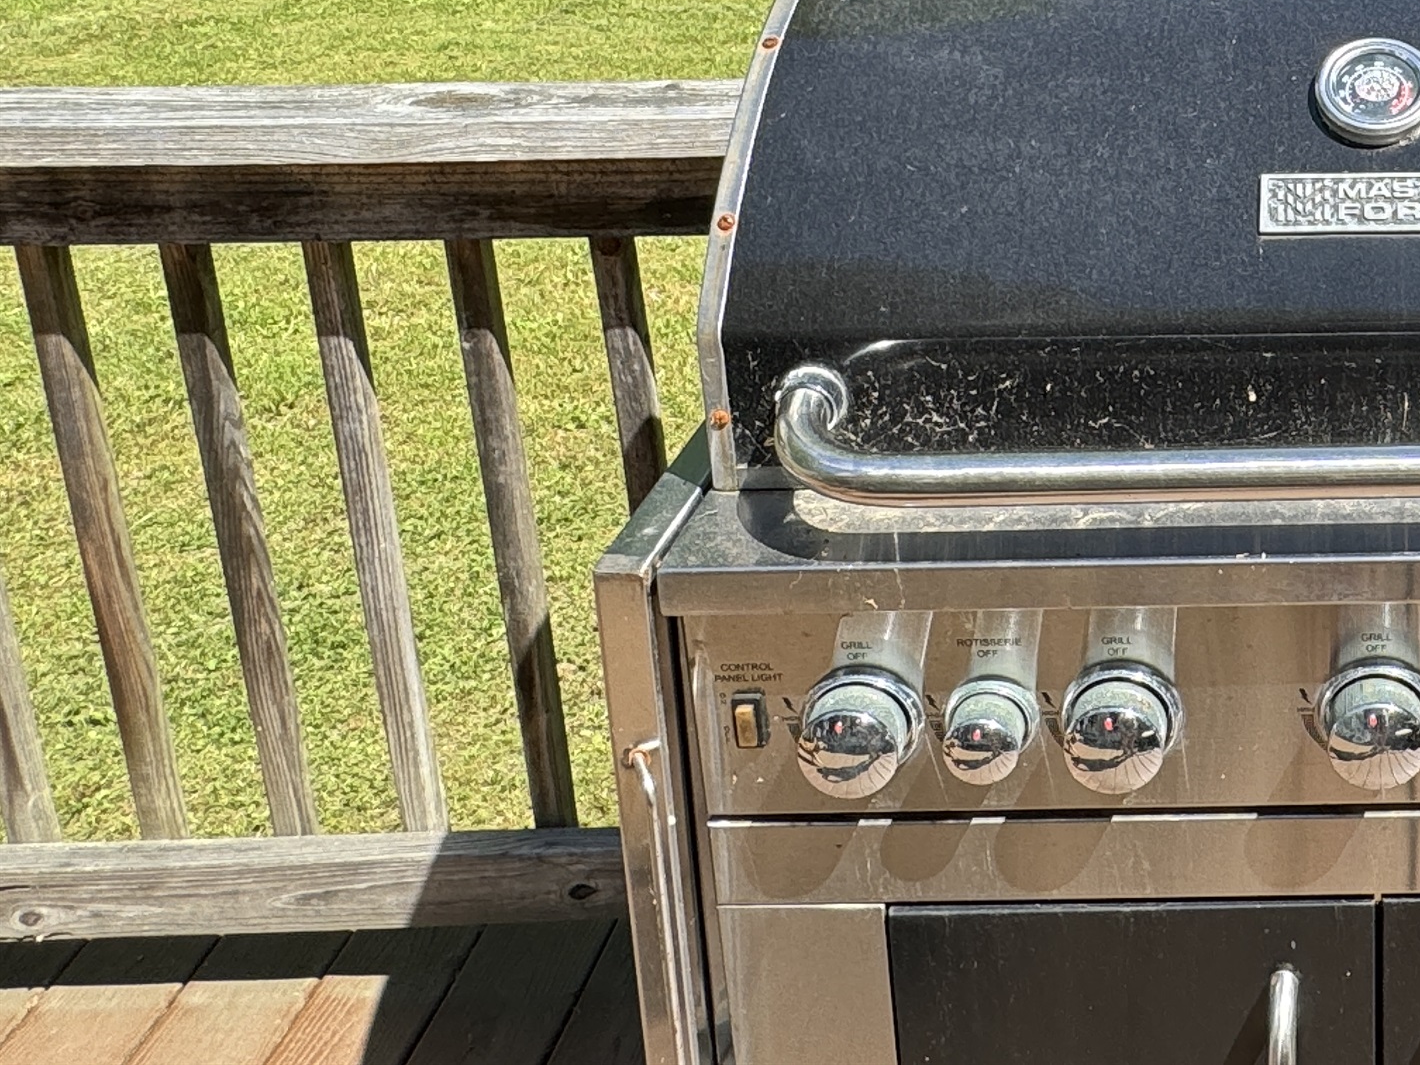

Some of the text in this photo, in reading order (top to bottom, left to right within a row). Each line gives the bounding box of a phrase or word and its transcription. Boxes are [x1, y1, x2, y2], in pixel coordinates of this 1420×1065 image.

[1101, 637, 1132, 646] GRILL
[1361, 633, 1393, 642] GRILL
[840, 641, 873, 650] GRILL
[956, 638, 1023, 647] ROTISSERIE
[1107, 648, 1129, 657] OFF
[1366, 644, 1388, 653] OFF
[847, 652, 868, 661] OFF
[976, 649, 998, 658] OFF
[720, 663, 774, 672] CONTROL
[714, 673, 783, 683] PANEL LIGHT
